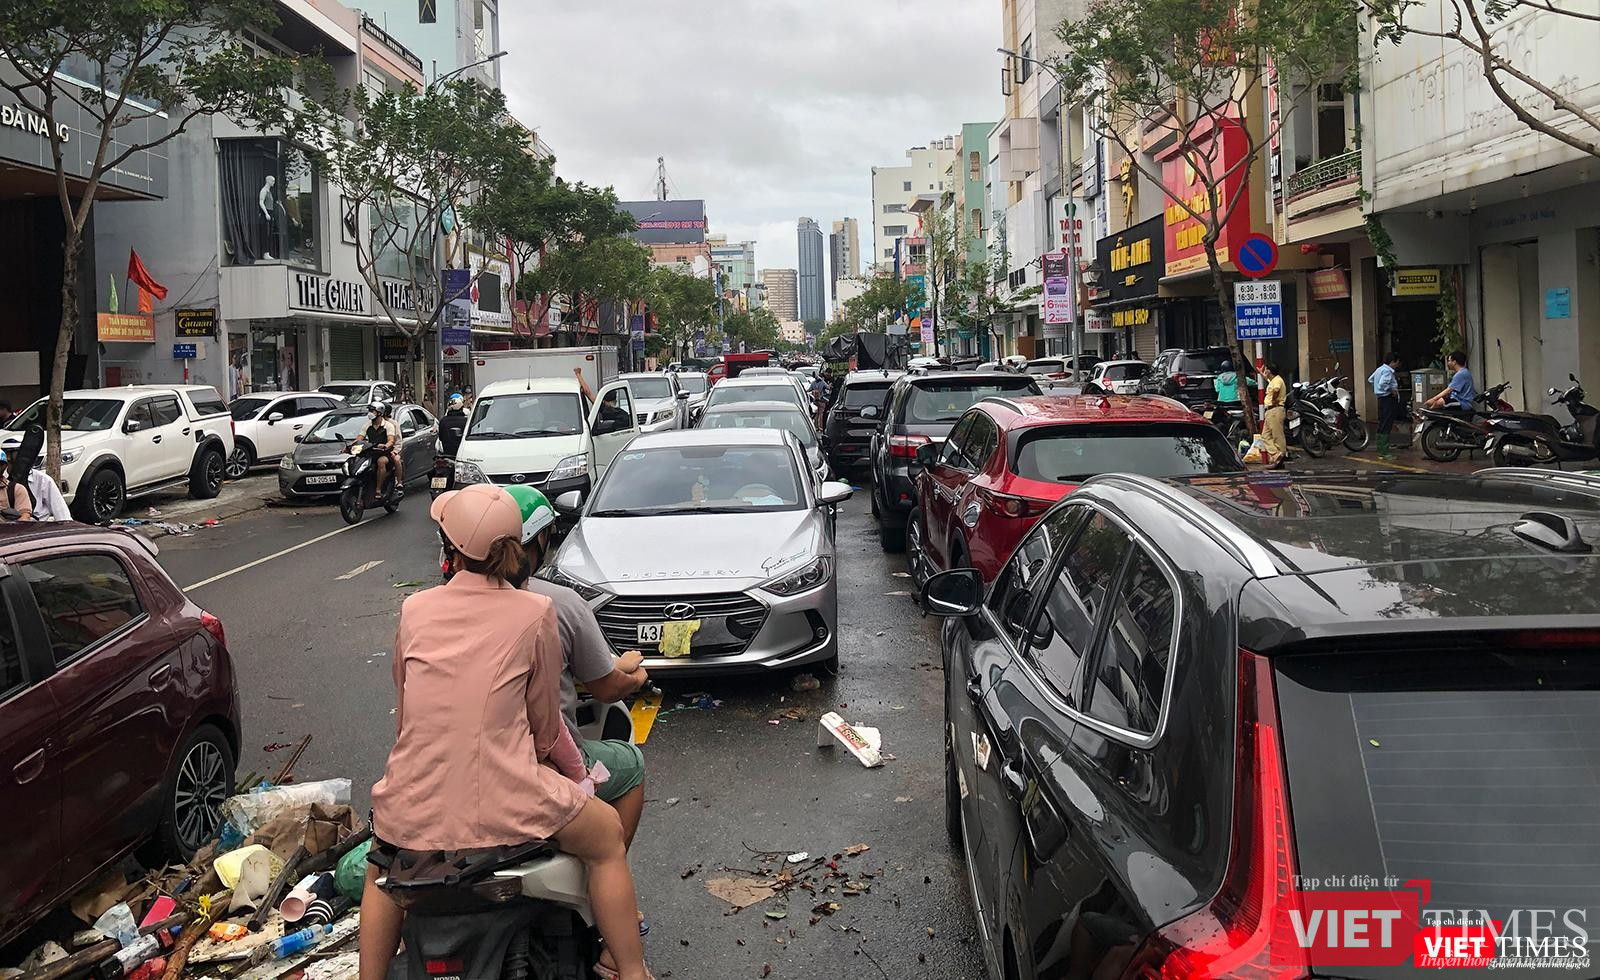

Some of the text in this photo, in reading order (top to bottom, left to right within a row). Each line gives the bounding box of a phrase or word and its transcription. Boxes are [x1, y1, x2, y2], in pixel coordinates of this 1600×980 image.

[1, 103, 25, 130] ĐÀ
[1062, 233, 1080, 243] KM
[297, 274, 365, 312] THE GMEN
[1240, 285, 1254, 293] 6:30
[1263, 284, 1276, 292] 8:00
[1238, 293, 1254, 301] 16:30
[1260, 292, 1277, 300] 18:00
[620, 568, 741, 579] DISCOVERY
[640, 625, 664, 641] 43
